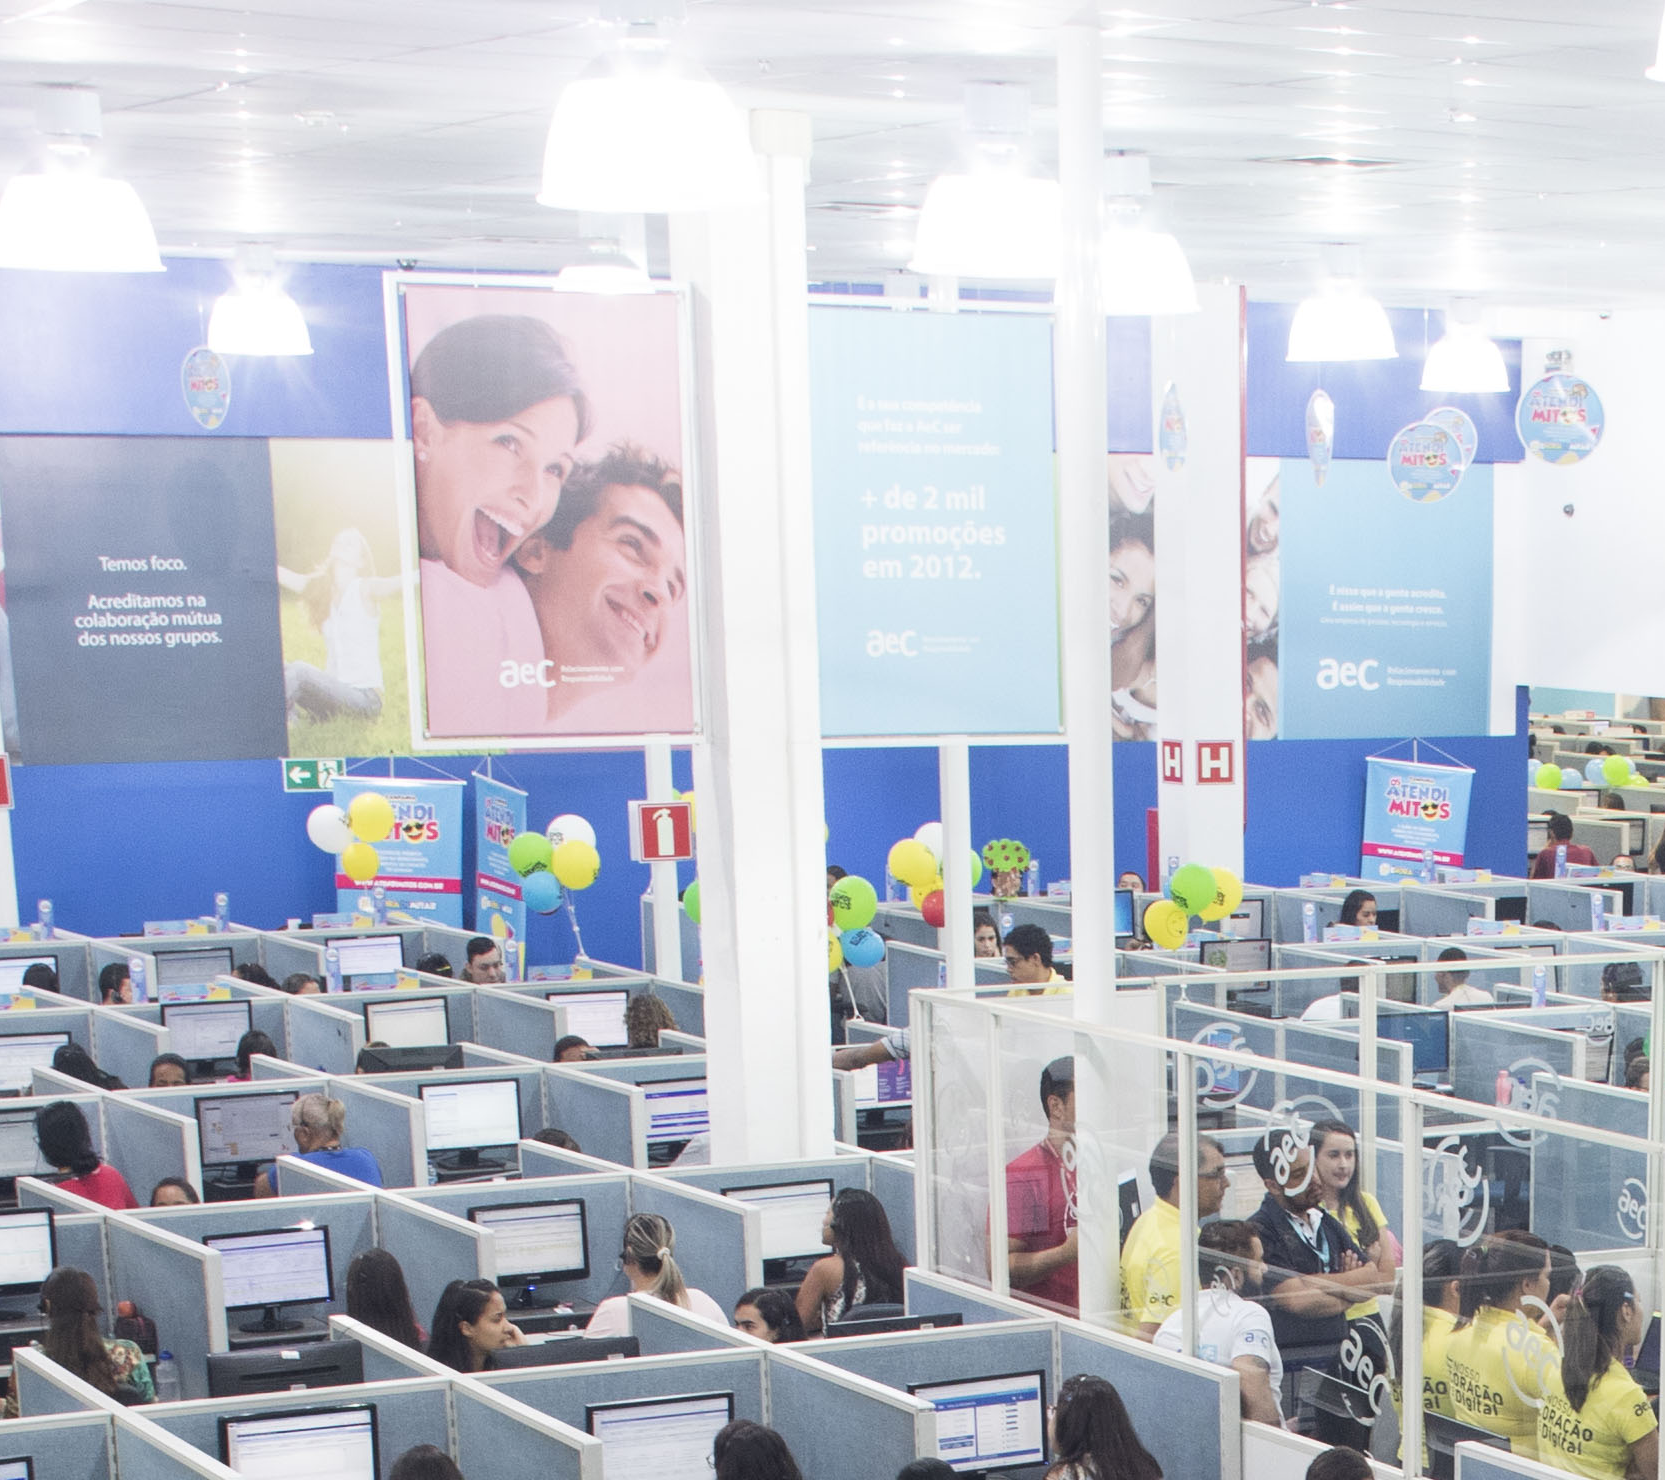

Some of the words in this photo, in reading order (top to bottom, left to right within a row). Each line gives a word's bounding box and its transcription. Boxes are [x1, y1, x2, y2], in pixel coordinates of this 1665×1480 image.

[884, 483, 918, 509] de
[922, 486, 940, 510] 2
[945, 484, 986, 510] mil
[862, 520, 1007, 551] promoções
[98, 556, 148, 572] Temos
[150, 555, 188, 571] foco.
[862, 559, 904, 578] em
[909, 554, 983, 579] 2012.
[87, 593, 185, 610] Acreditamos
[186, 596, 207, 609] na
[74, 611, 170, 631] colaboração
[172, 610, 223, 626] mútua
[78, 631, 107, 647] dos
[109, 631, 163, 646] nossos
[164, 631, 223, 648] grupos.
[1164, 745, 1181, 778] H
[1201, 746, 1229, 778] H
[1386, 784, 1447, 802] ATENDI
